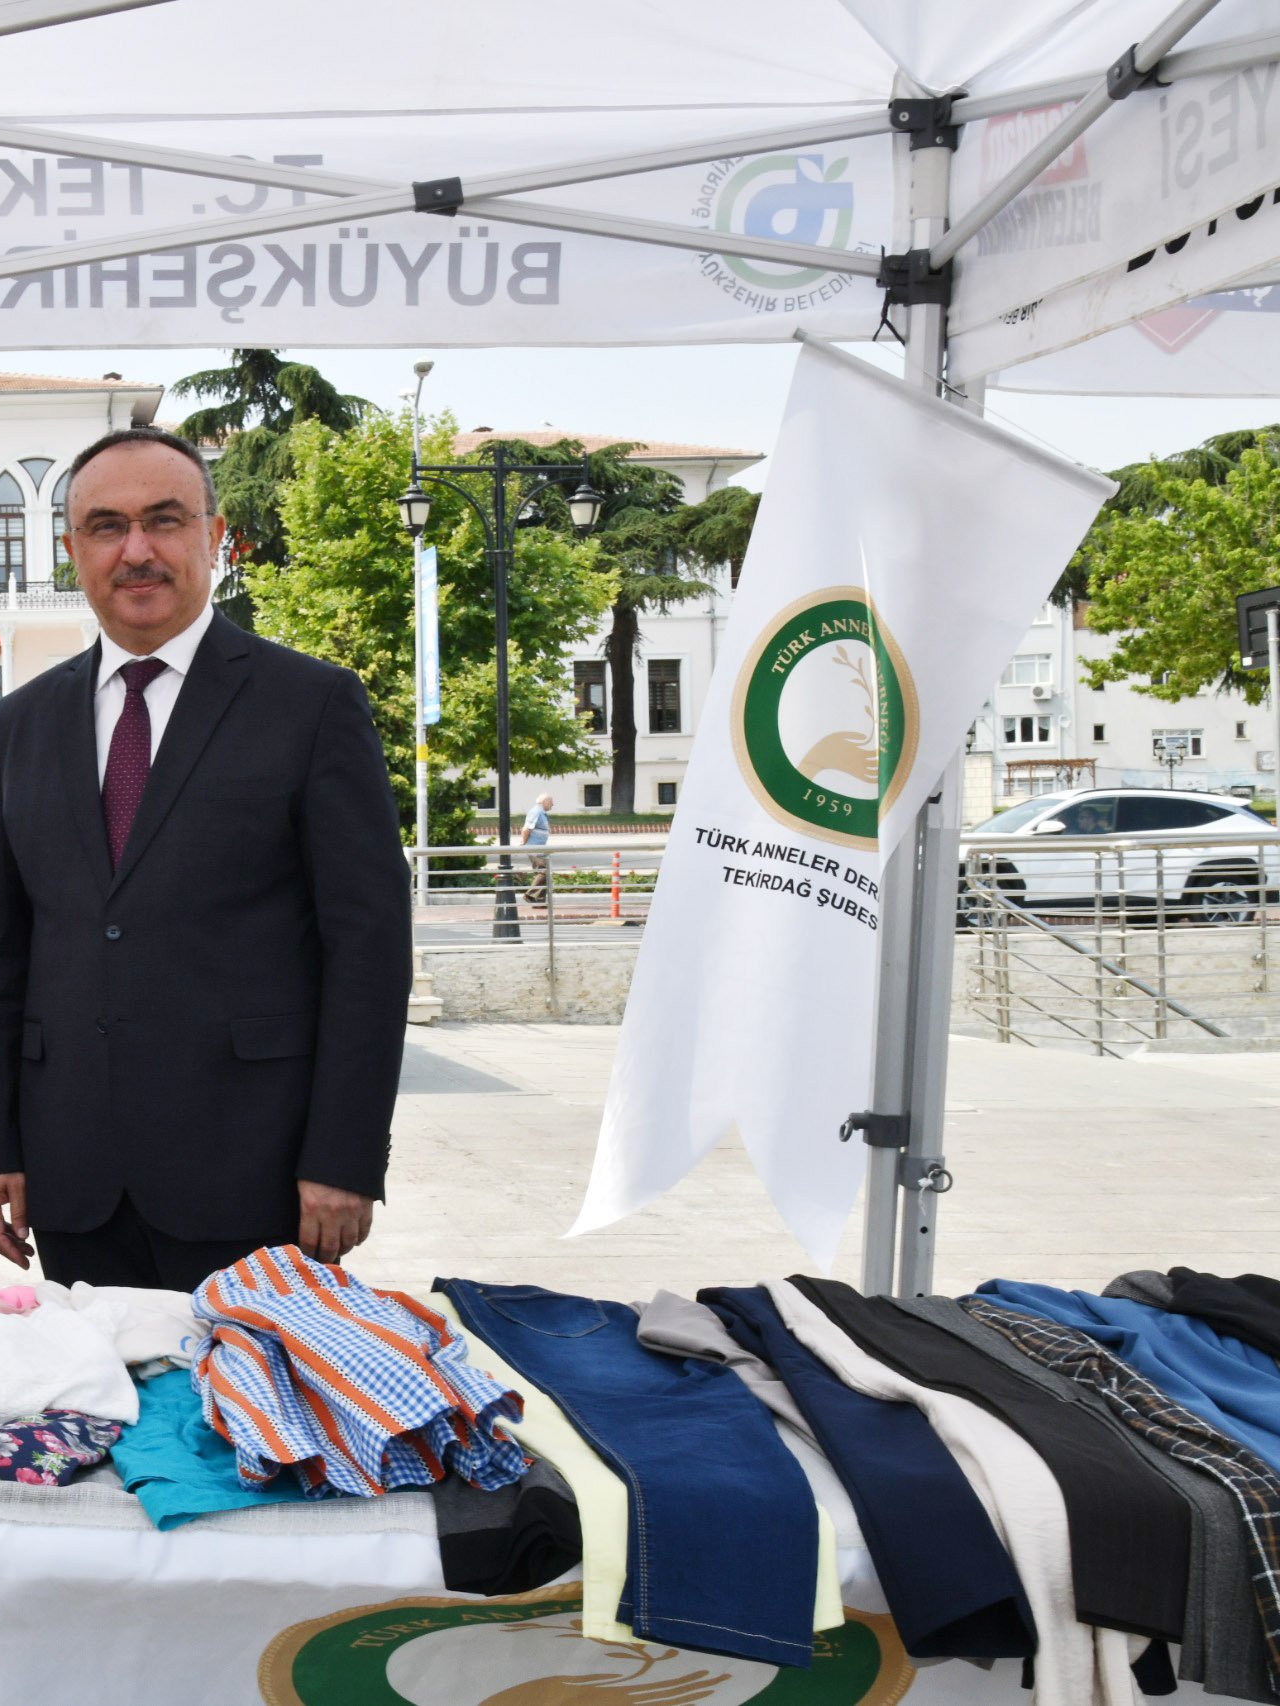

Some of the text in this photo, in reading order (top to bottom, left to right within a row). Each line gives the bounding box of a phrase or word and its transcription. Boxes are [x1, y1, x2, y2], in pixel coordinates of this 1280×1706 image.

[771, 629, 817, 677] TÜRK
[803, 788, 853, 816] 1959
[695, 827, 880, 903] TÜRK ANNELER DER
[722, 866, 811, 899] TEKİRDAĞ
[349, 1619, 451, 1650] TÜRK
